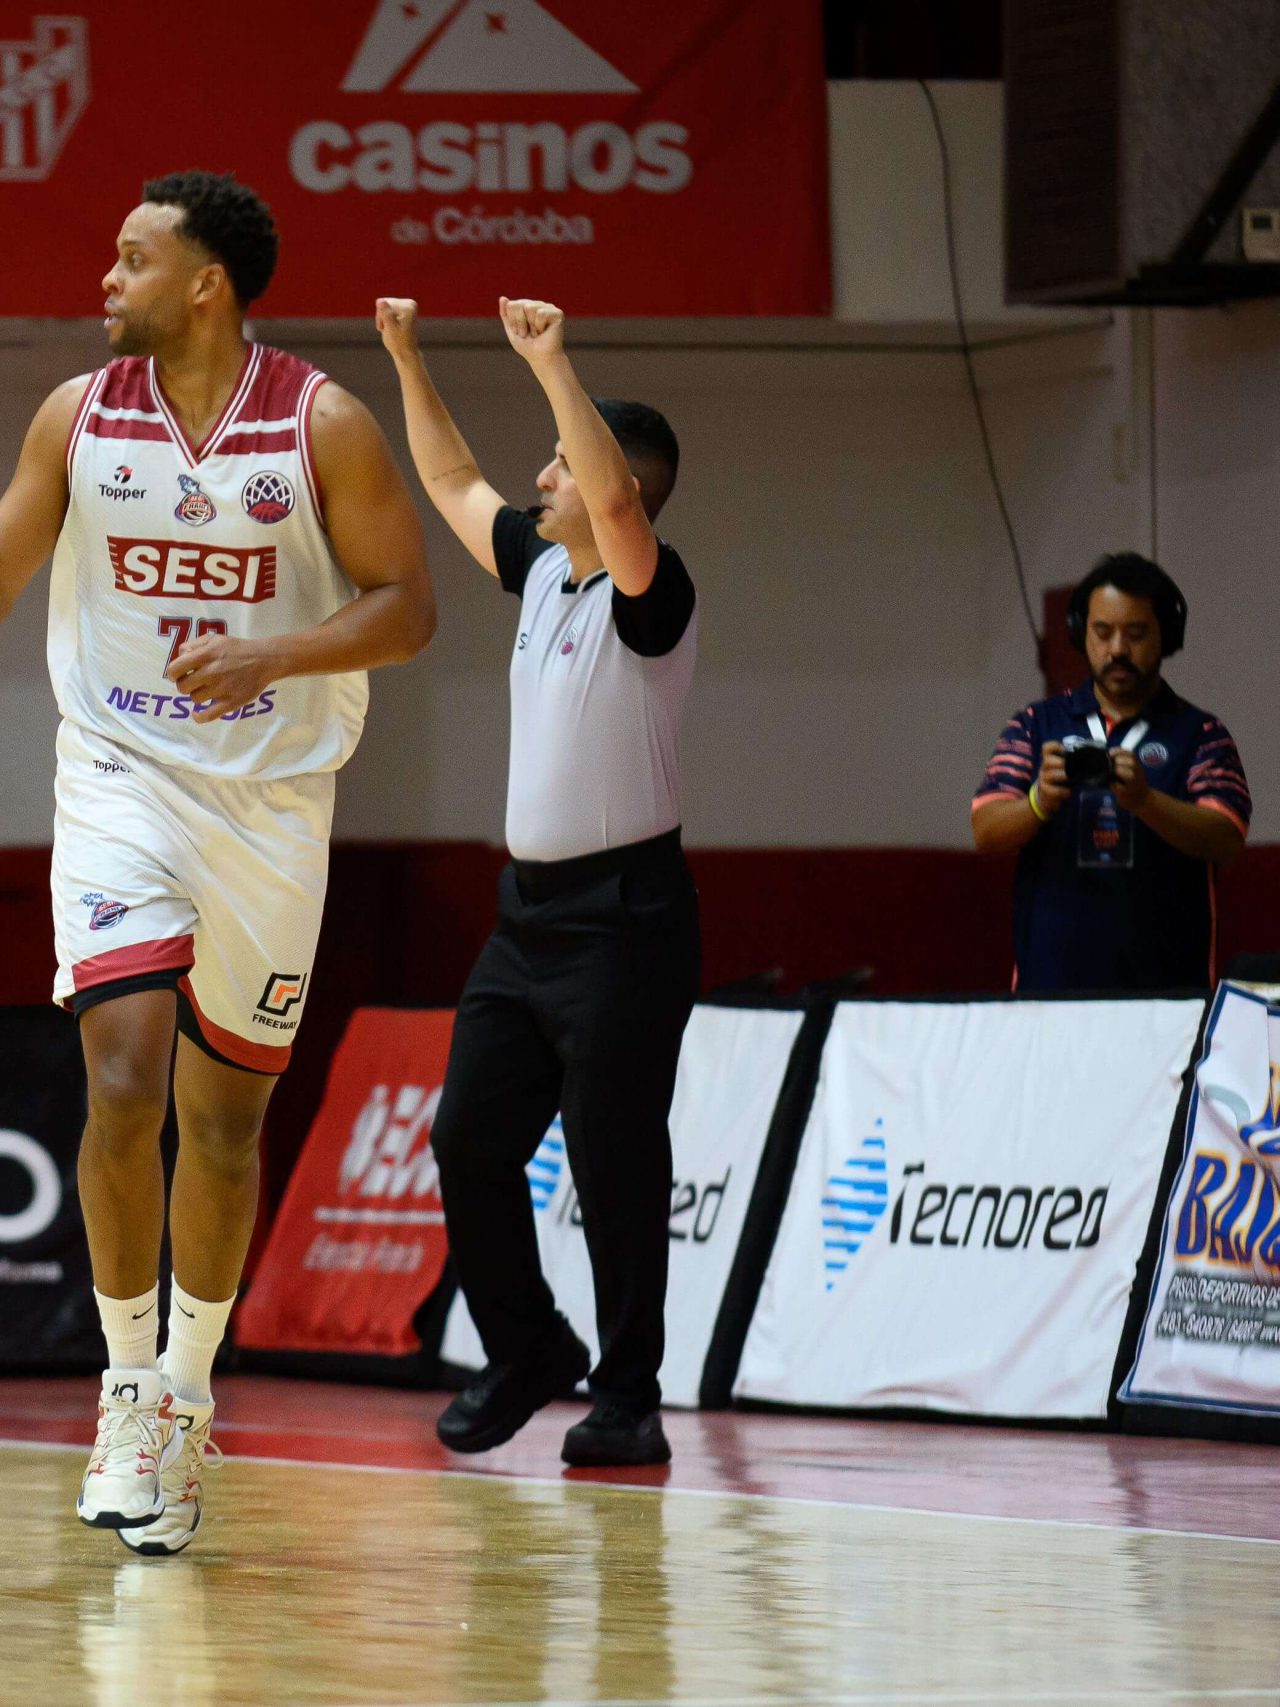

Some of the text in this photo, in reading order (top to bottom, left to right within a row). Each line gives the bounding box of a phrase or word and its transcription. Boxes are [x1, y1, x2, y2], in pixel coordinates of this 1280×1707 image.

[289, 120, 693, 194] casinos
[391, 206, 594, 244] de Córdoba
[98, 484, 147, 501] Topper
[122, 545, 261, 600] SESI
[93, 760, 130, 773] Topp
[252, 1013, 298, 1030] FREEWAY
[889, 1162, 1112, 1250] Tecnored
[1198, 1278, 1267, 1307] DEPORTIVOS
